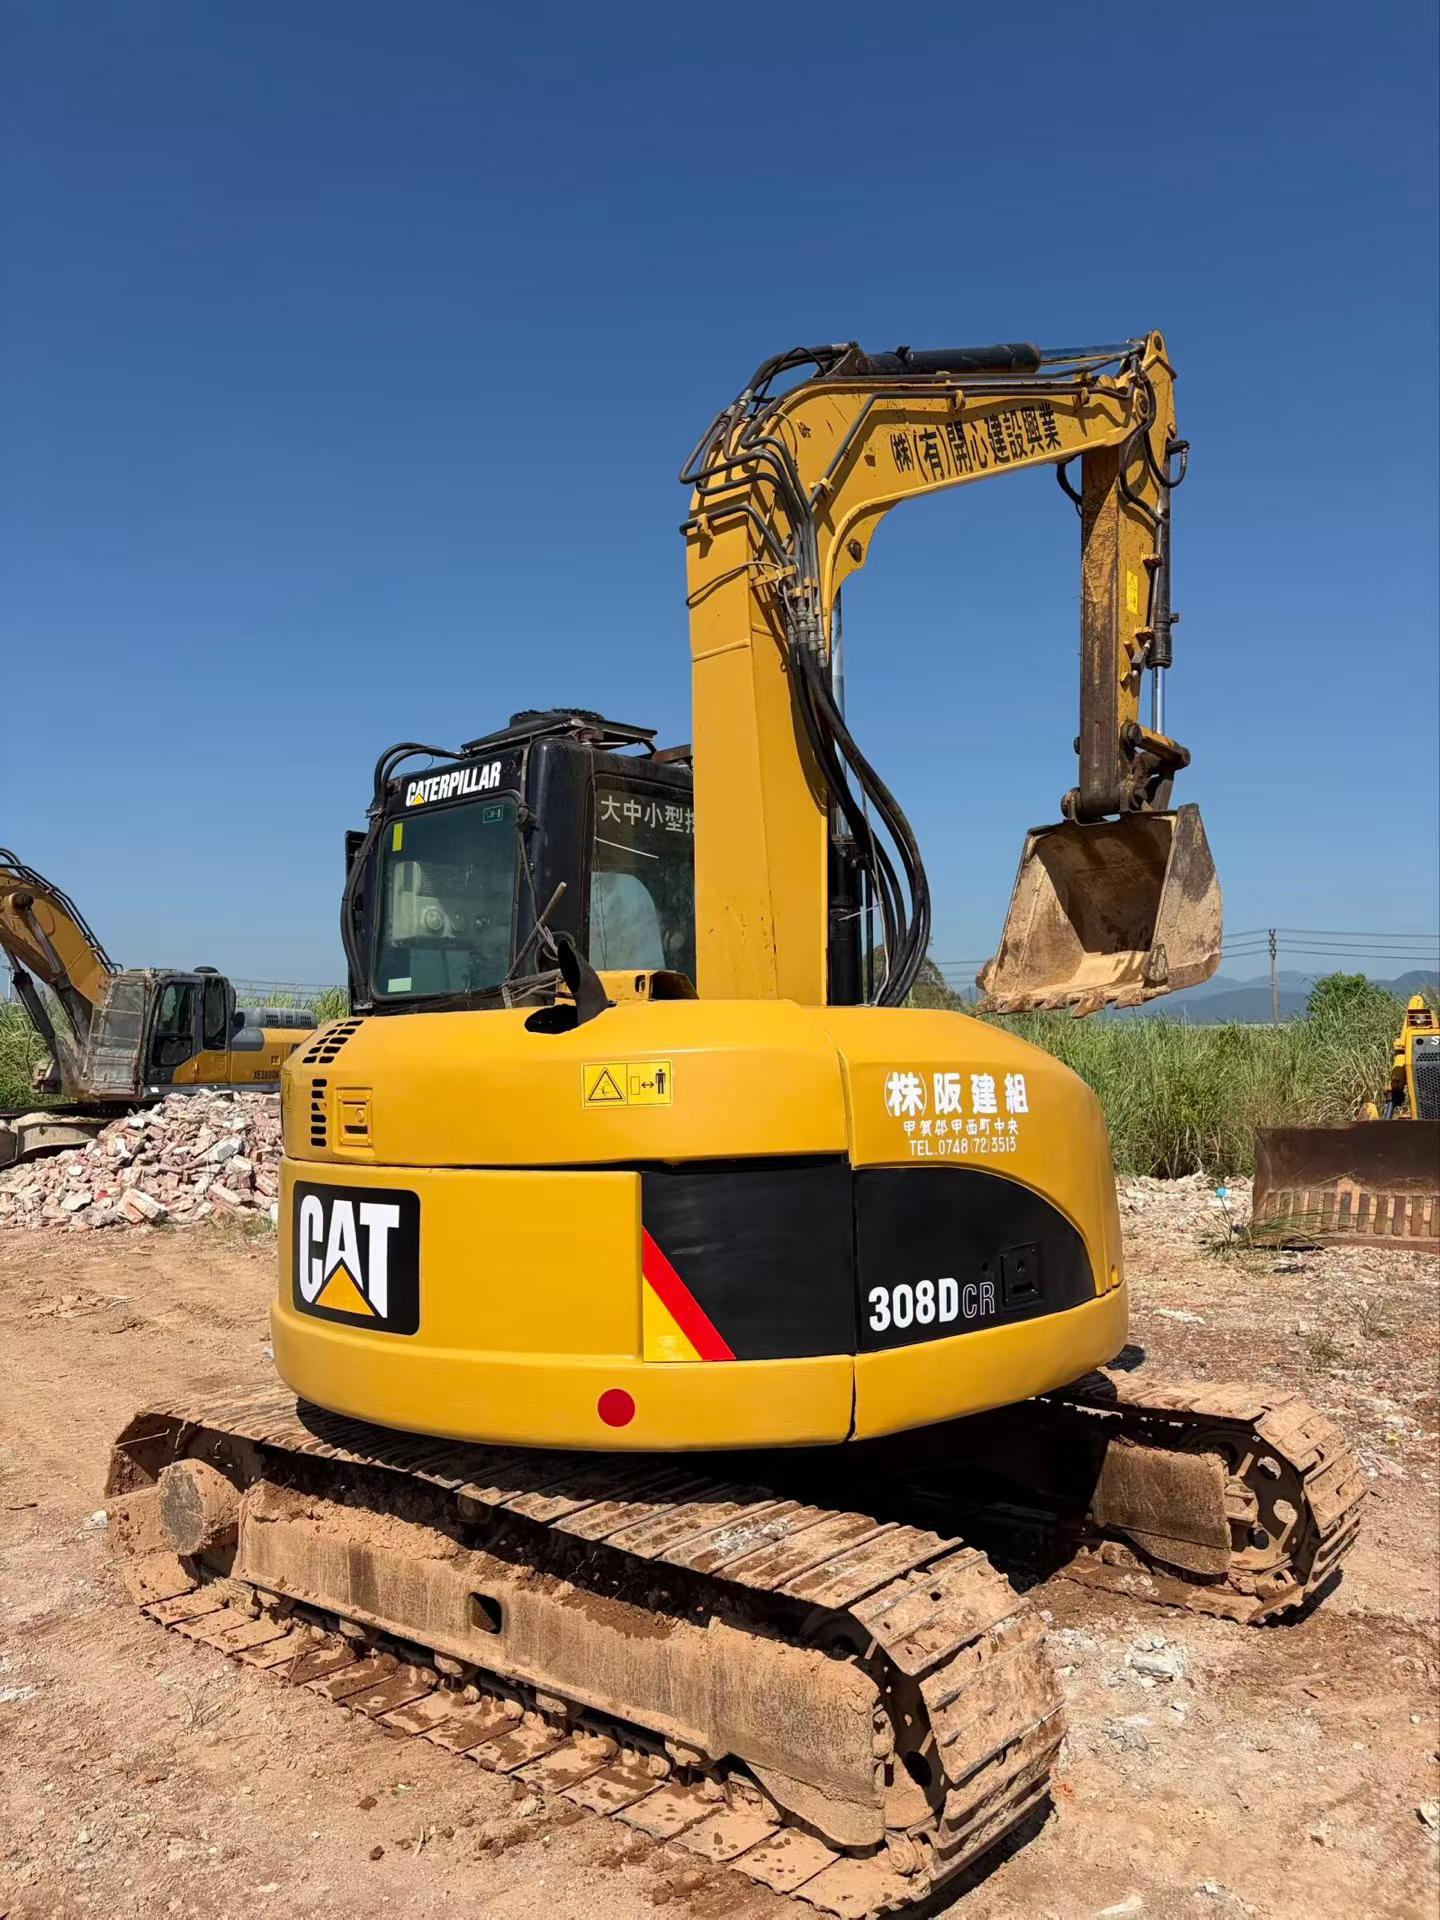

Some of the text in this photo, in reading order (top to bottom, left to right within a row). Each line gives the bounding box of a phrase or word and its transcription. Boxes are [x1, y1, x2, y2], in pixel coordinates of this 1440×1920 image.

[405, 761, 501, 807] CATERPILLAR
[300, 1195, 400, 1318] CAT
[868, 1278, 995, 1331] 308D CR
